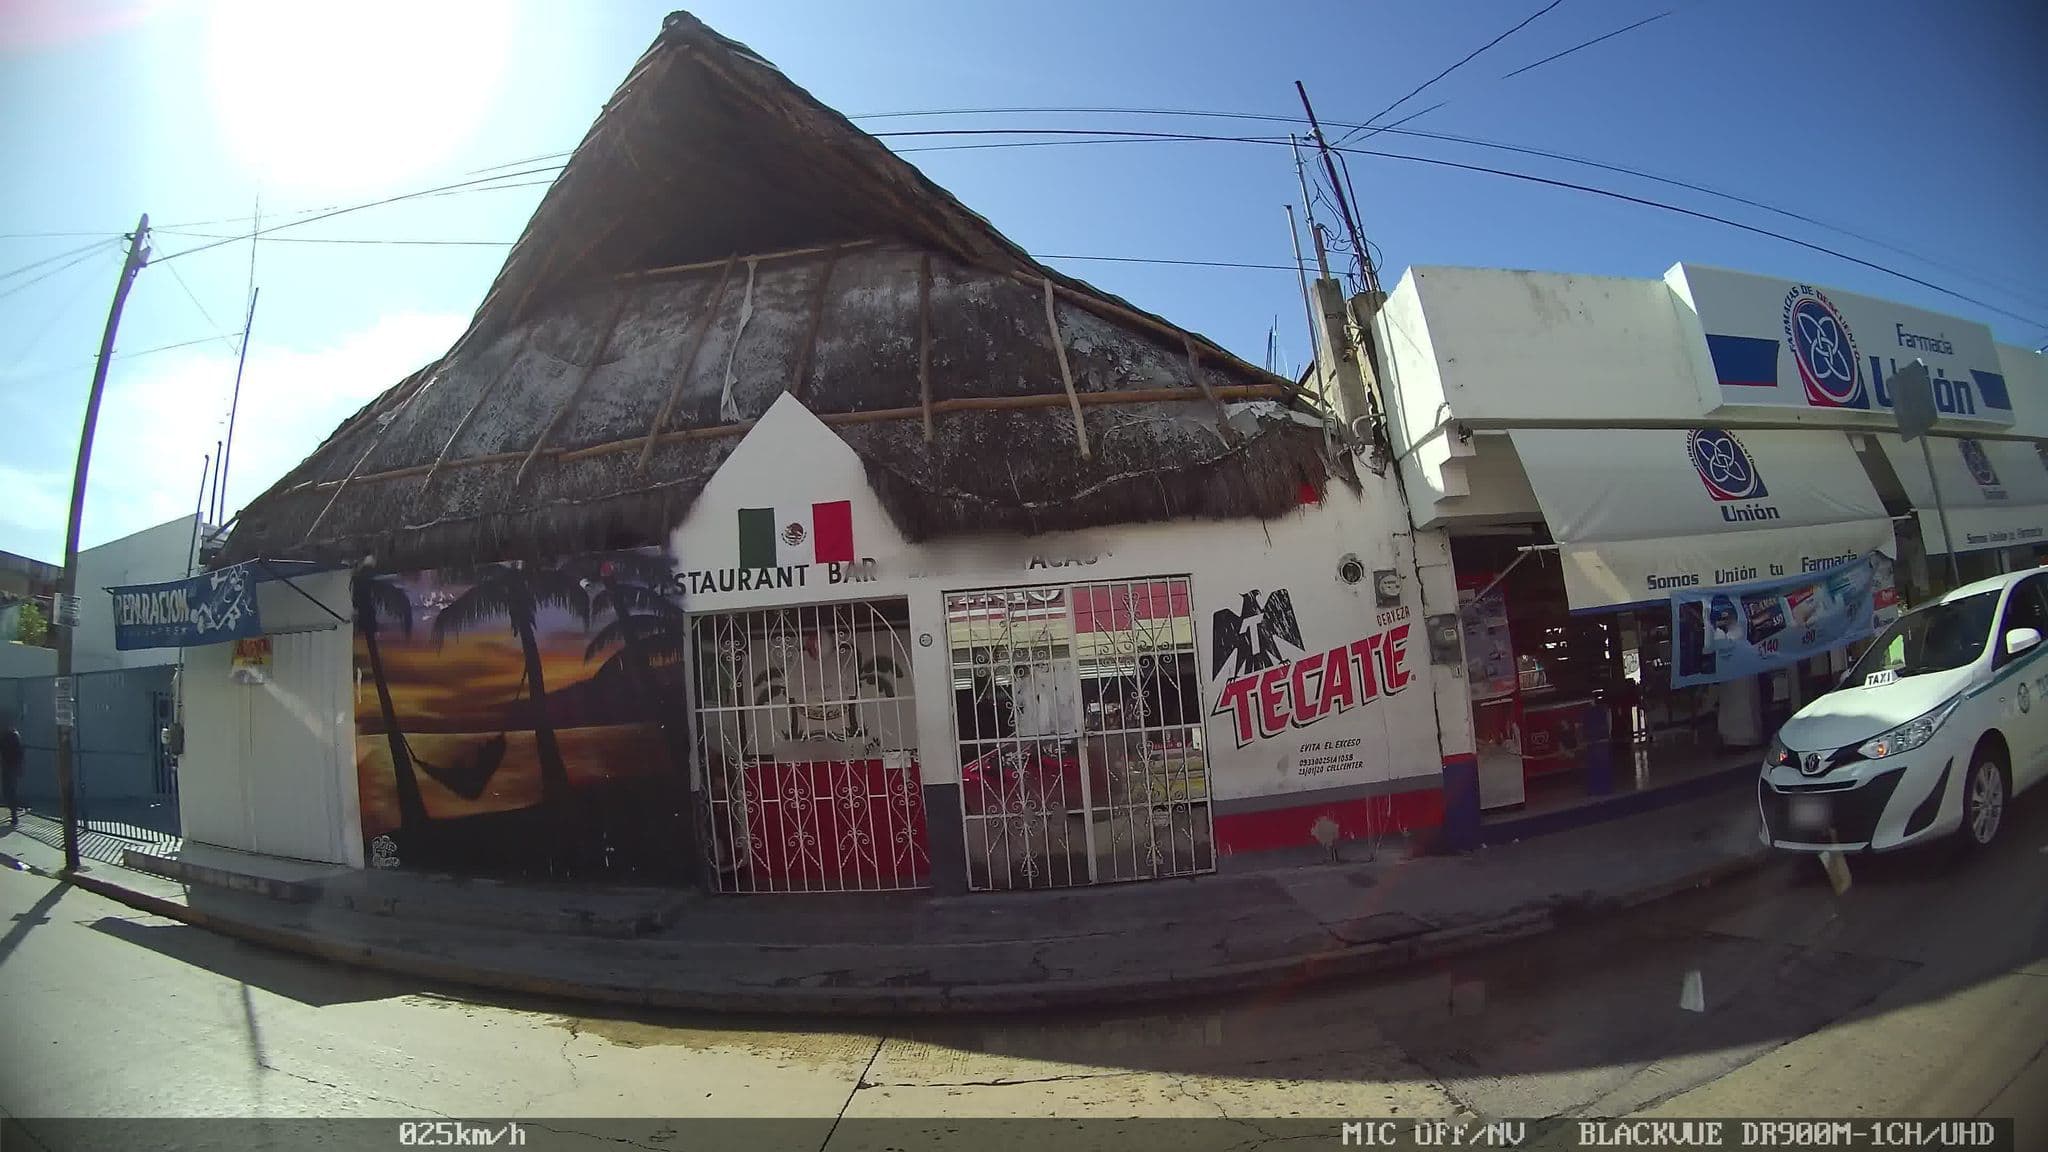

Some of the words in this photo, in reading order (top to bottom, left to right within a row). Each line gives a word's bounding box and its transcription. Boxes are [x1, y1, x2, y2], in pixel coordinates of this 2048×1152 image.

[1896, 323, 1954, 355] Farmacia
[1869, 355, 1976, 415] Uón
[1721, 503, 1780, 522] Unión
[1646, 573, 1699, 590] Somos
[1715, 564, 1757, 585] Unión
[1769, 562, 1784, 576] tu
[113, 588, 191, 627] REPARACION
[1376, 605, 1411, 627] CERVEZA
[1211, 624, 1411, 751] TECATE
[1867, 673, 1892, 686] TAXI
[1299, 743, 1321, 753] EVITA
[1324, 741, 1334, 750] EL
[1335, 738, 1361, 749] EXCESO
